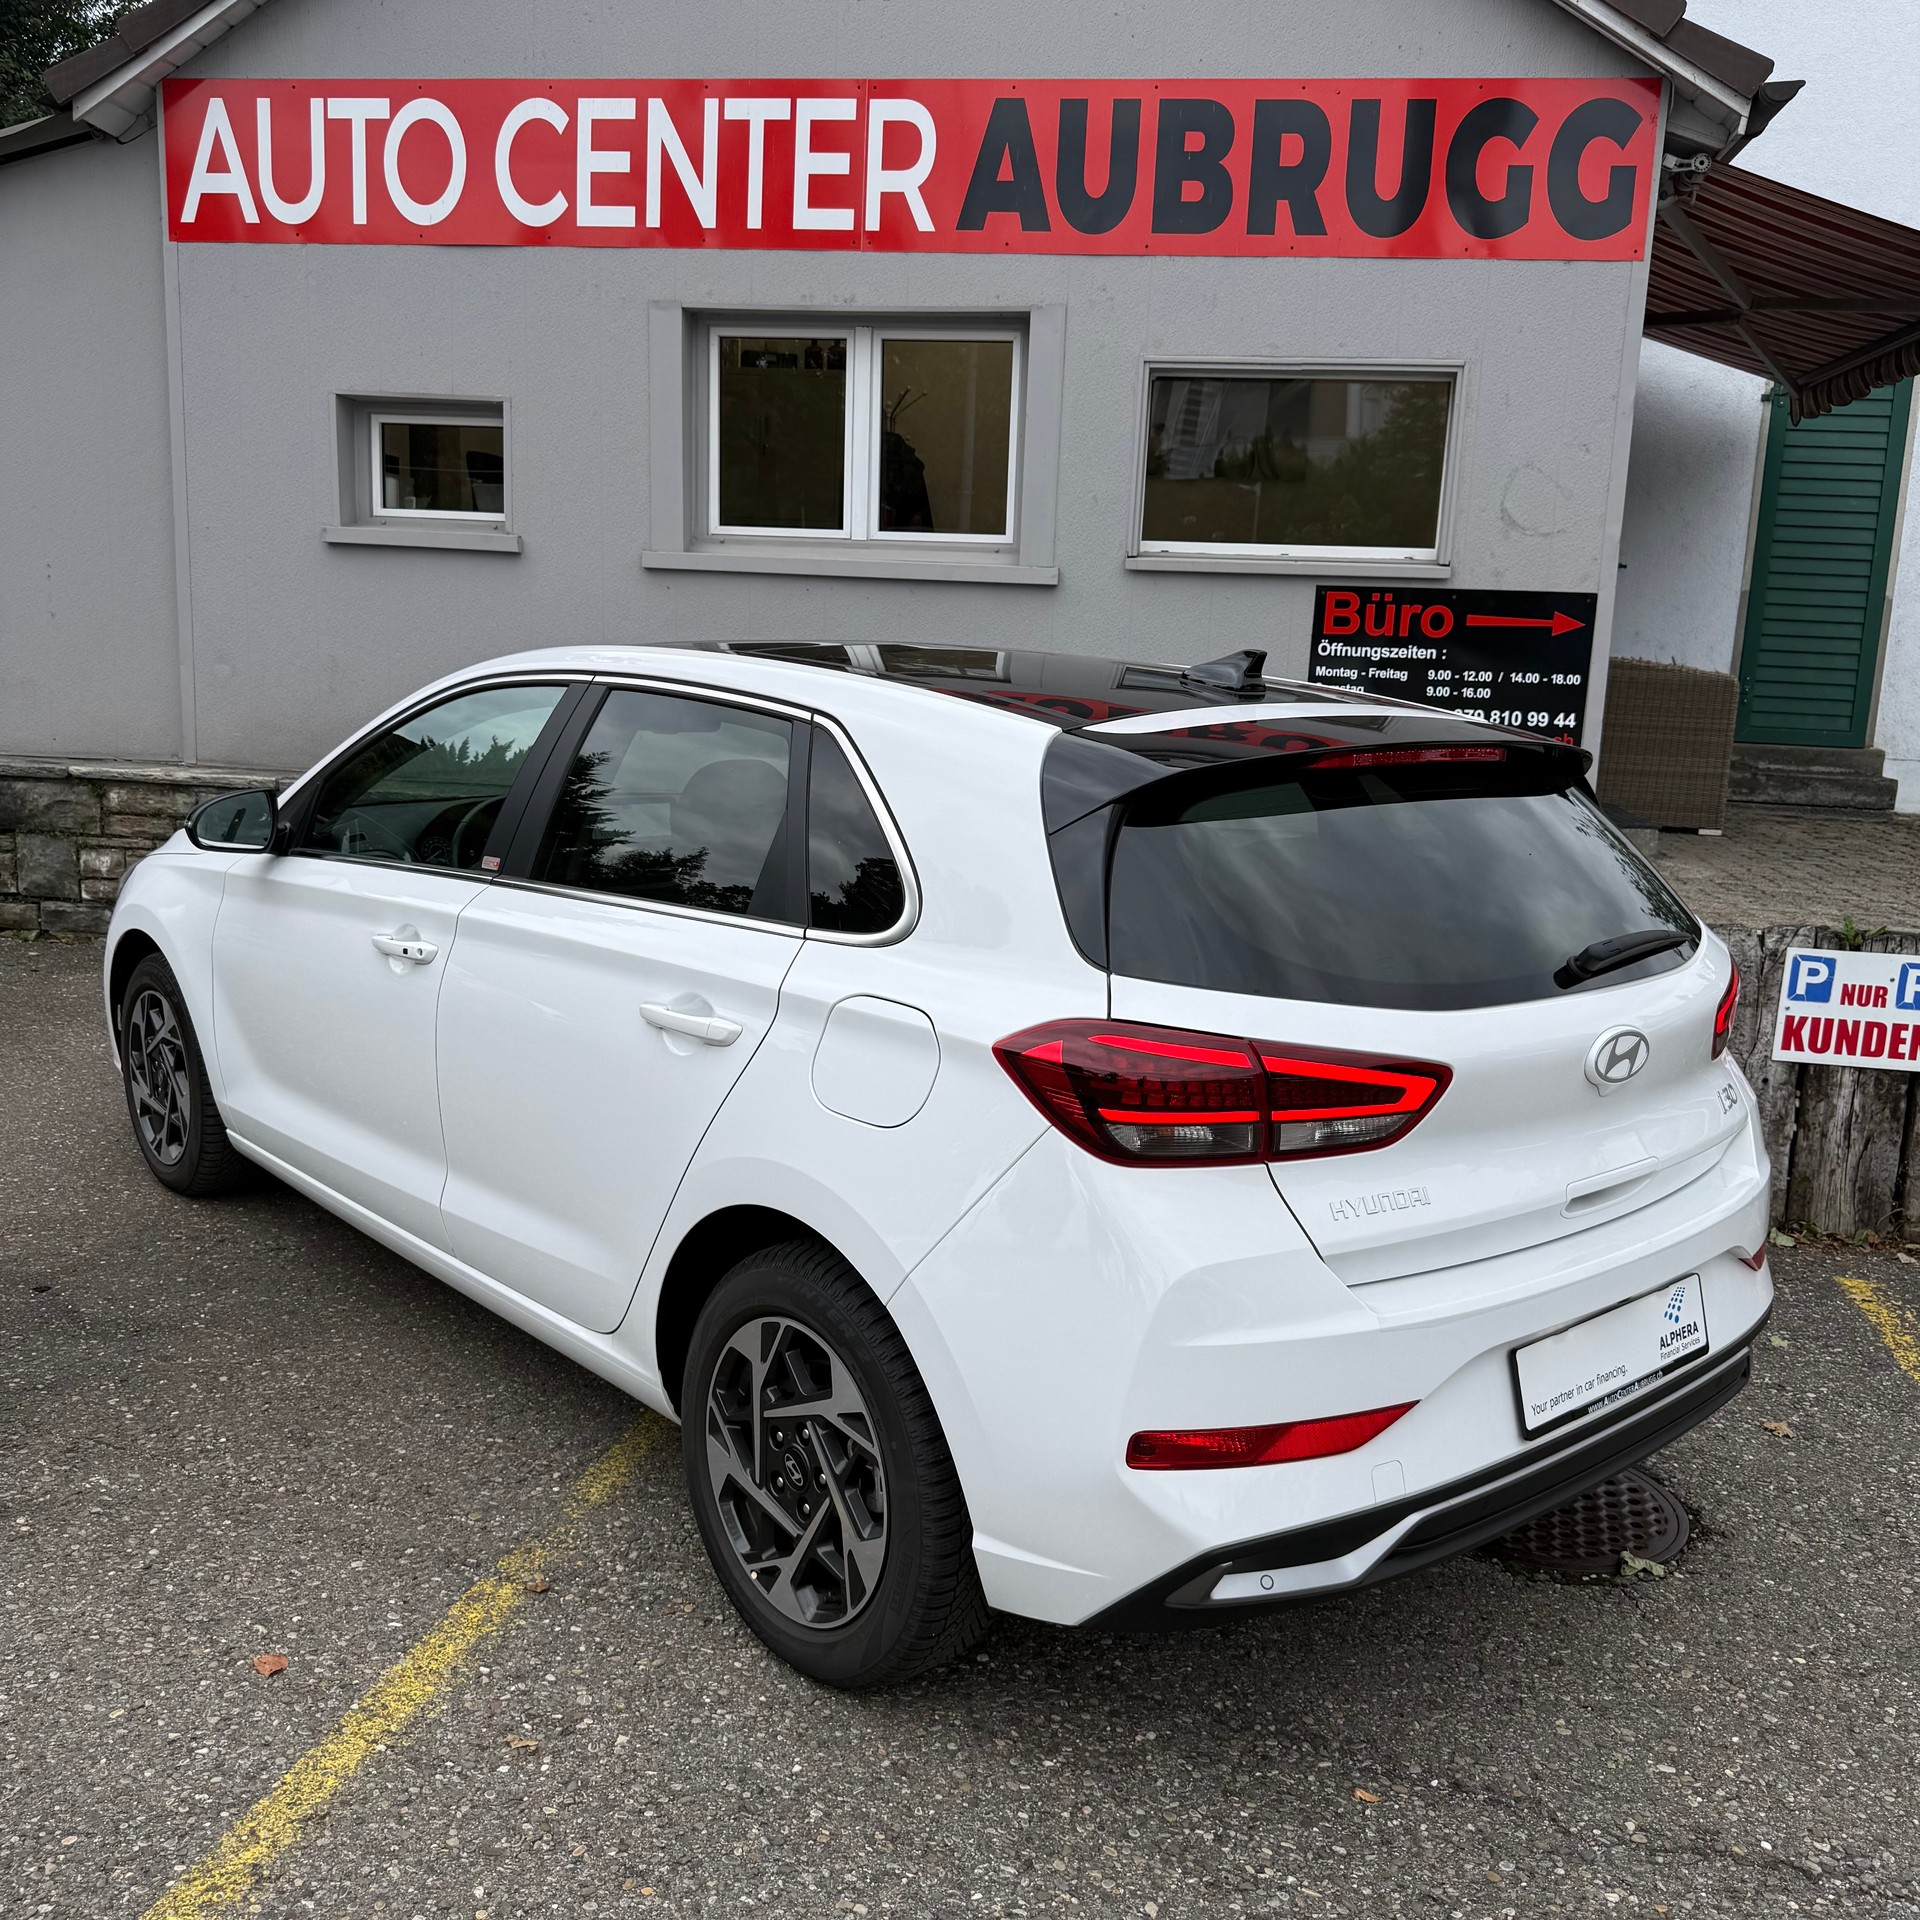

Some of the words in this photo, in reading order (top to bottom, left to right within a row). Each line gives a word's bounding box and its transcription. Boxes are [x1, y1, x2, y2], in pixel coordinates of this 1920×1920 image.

[180, 97, 467, 227] AUTO
[496, 97, 936, 232] CENTER
[955, 97, 1644, 241] AUBRUGG
[1323, 591, 1454, 638] Büro
[1317, 639, 1437, 661] Öffnungszeiten
[1315, 666, 1358, 679] Montag
[1368, 668, 1408, 681] Freitag
[1427, 669, 1452, 681] 9.00
[1462, 671, 1493, 682] 12.00
[1509, 672, 1540, 684] 14.00
[1550, 674, 1581, 685] 18.00
[1426, 686, 1450, 697] 9.00
[1461, 687, 1491, 699] 16.00
[1489, 709, 1522, 726] 810
[1526, 711, 1549, 728] 99
[1553, 712, 1577, 729] 44
[1839, 983, 1889, 1009] NUR
[1328, 1186, 1431, 1221] HYUNDAI
[1659, 1320, 1699, 1351] ALPHERA
[1530, 1400, 1548, 1416] Your
[1549, 1388, 1575, 1411] partner
[1575, 1384, 1583, 1396] in
[1584, 1378, 1595, 1391] car
